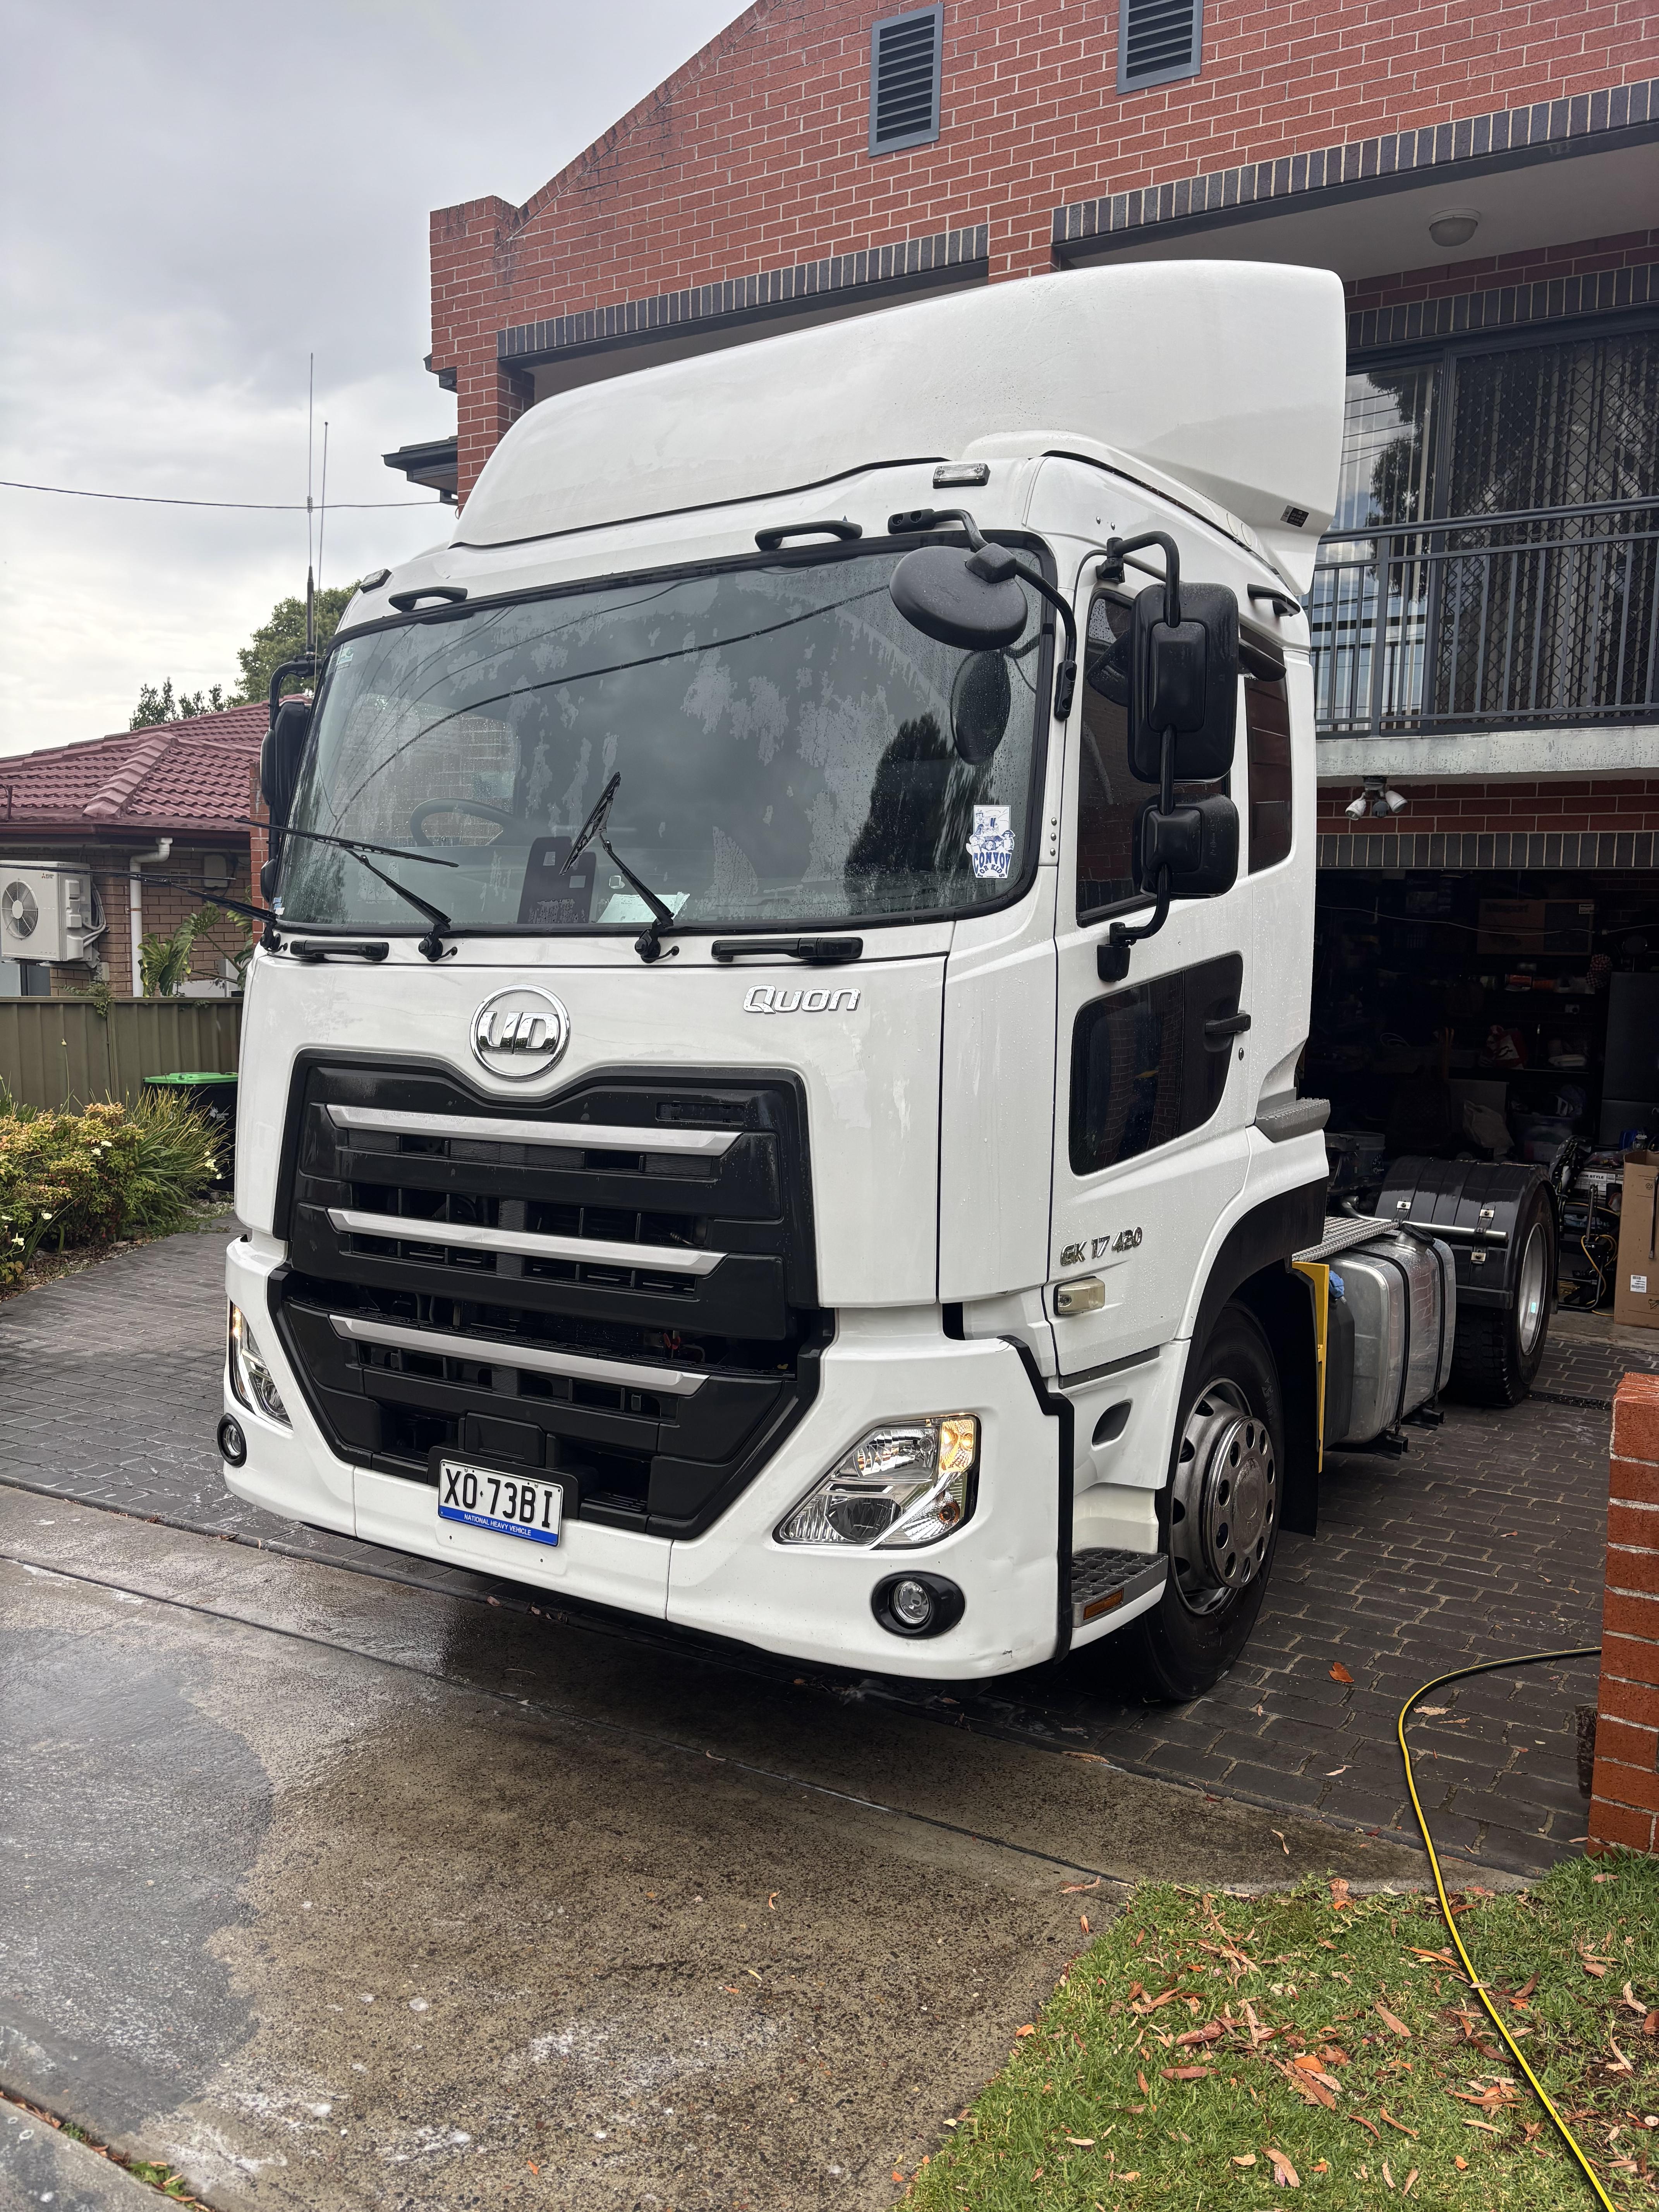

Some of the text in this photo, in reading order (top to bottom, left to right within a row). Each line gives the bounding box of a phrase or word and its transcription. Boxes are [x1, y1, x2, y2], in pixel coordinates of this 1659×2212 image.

[973, 852, 1011, 875] CONVOY
[977, 864, 1005, 878] FOR KIDS
[477, 1011, 560, 1055] UD
[1091, 1235, 1110, 1259] 17
[1111, 1226, 1142, 1252] 420
[464, 1513, 532, 1536] NATIONAL HEAVY VEHICLE
